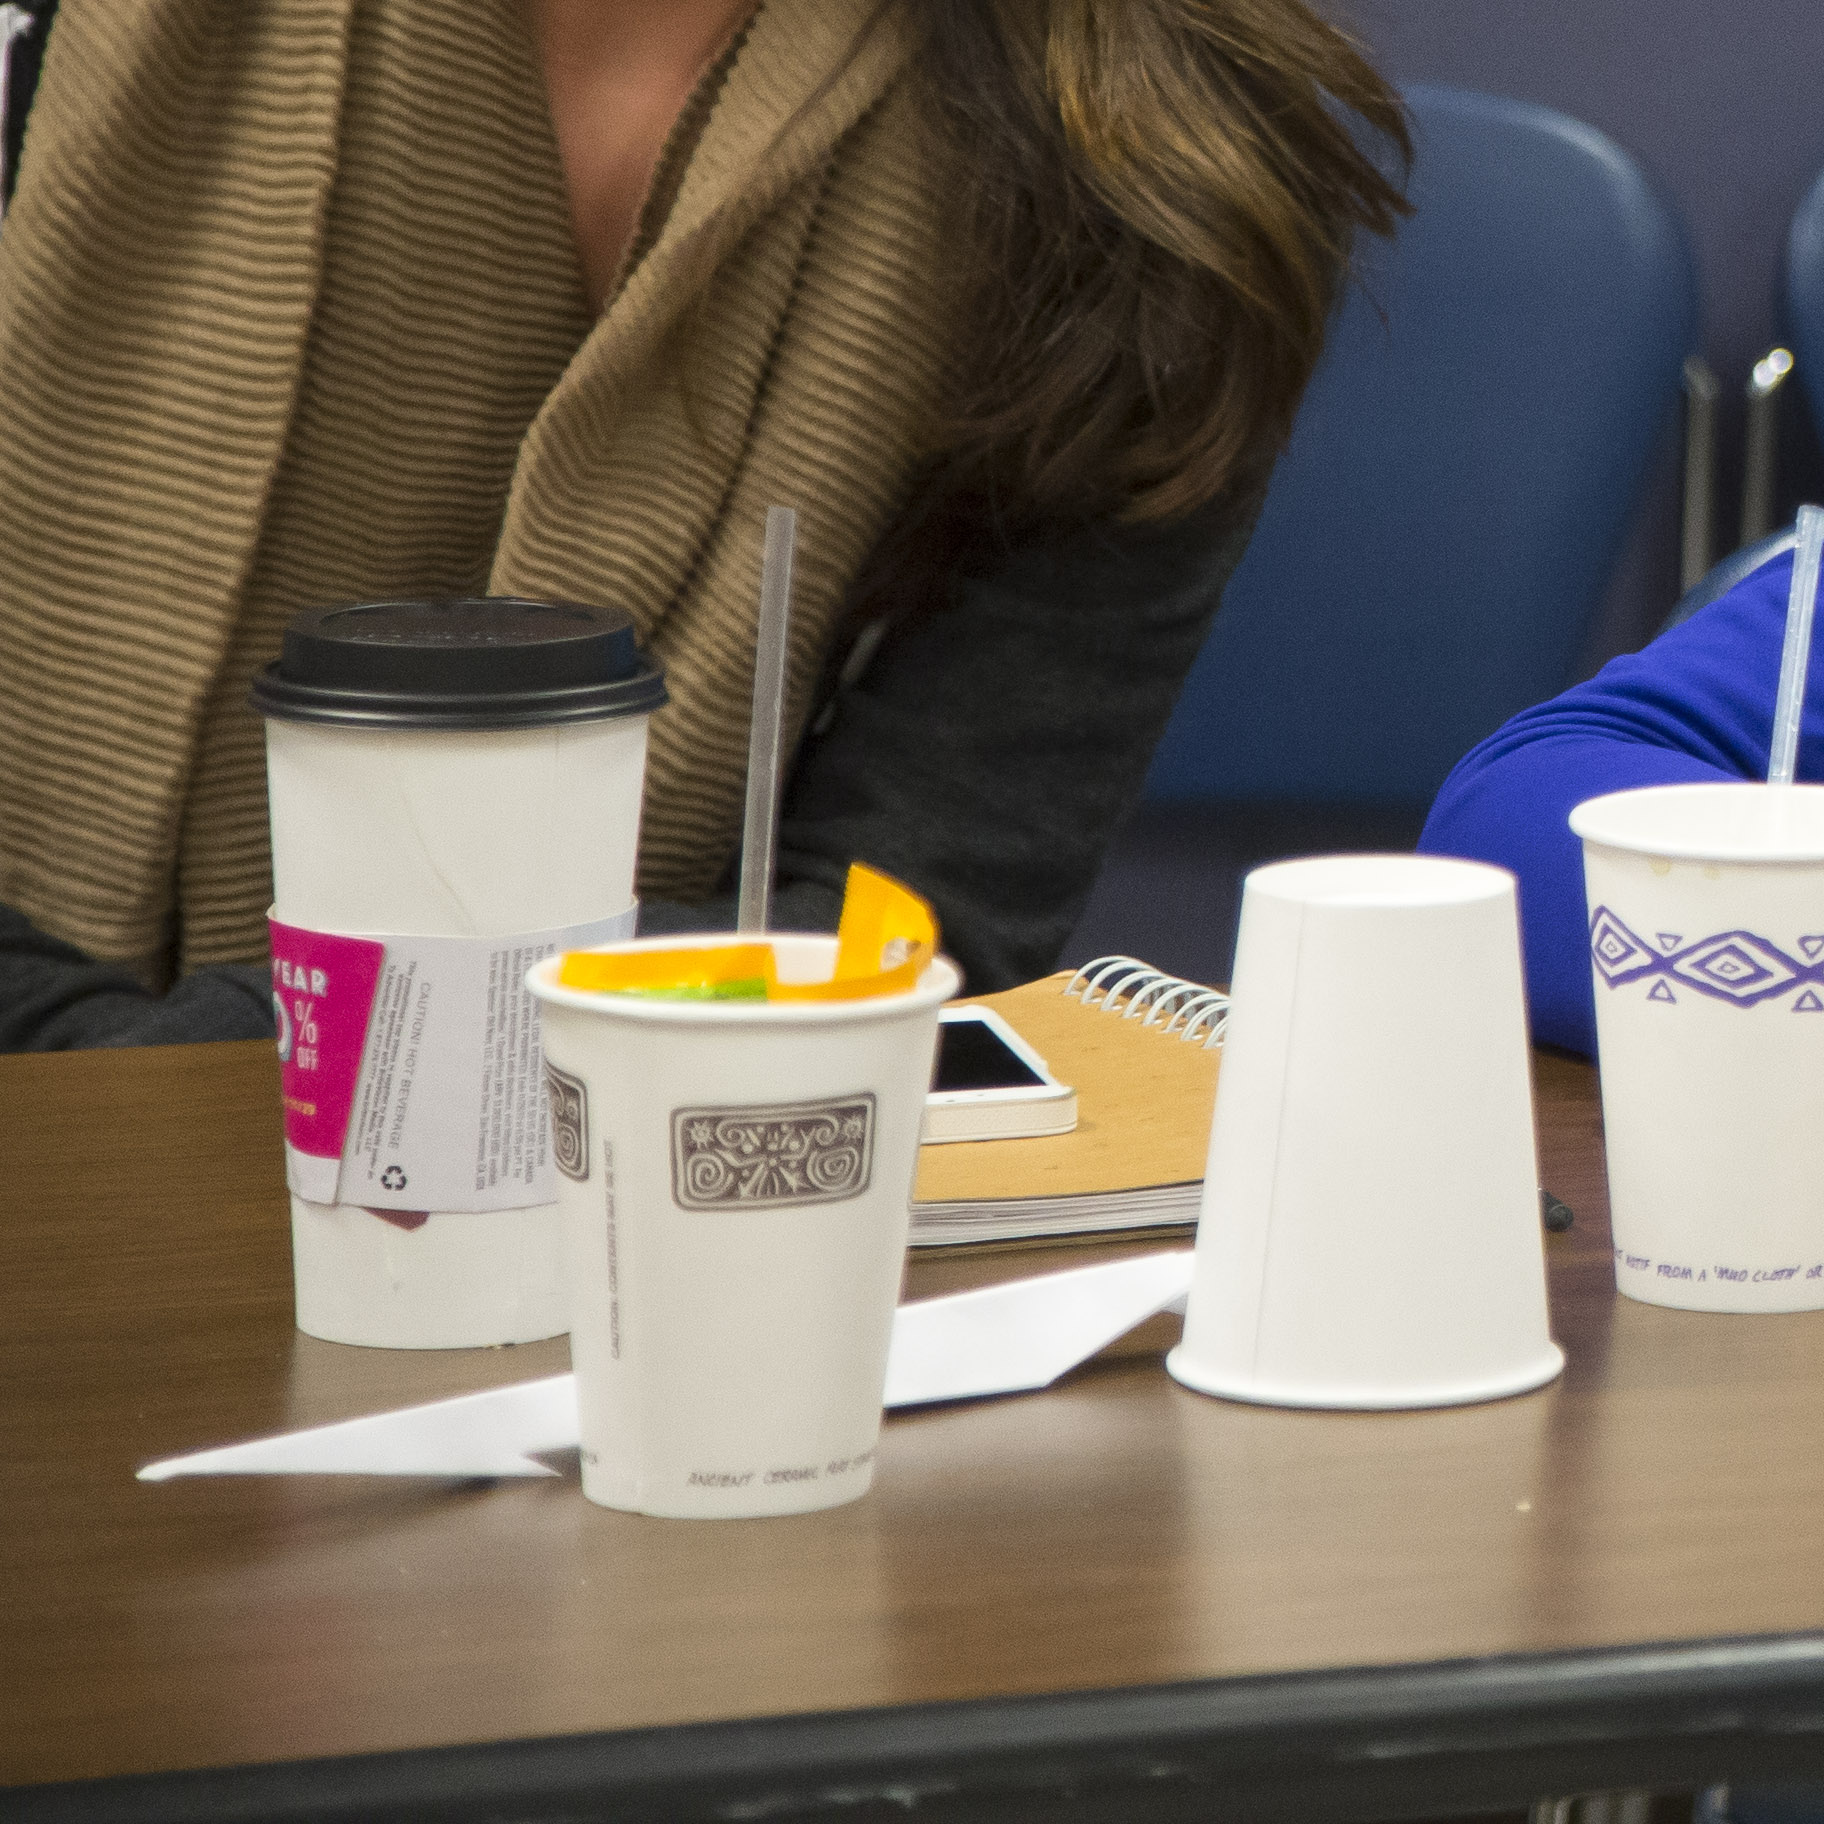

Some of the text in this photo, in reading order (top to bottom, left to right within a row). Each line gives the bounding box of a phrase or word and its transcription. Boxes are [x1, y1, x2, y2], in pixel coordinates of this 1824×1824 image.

[387, 981, 431, 1150] CAUTION! HOT BEVERAGE
[1656, 1263, 1693, 1281] FROM
[1697, 1269, 1707, 1282] A
[1805, 1263, 1823, 1280] OR
